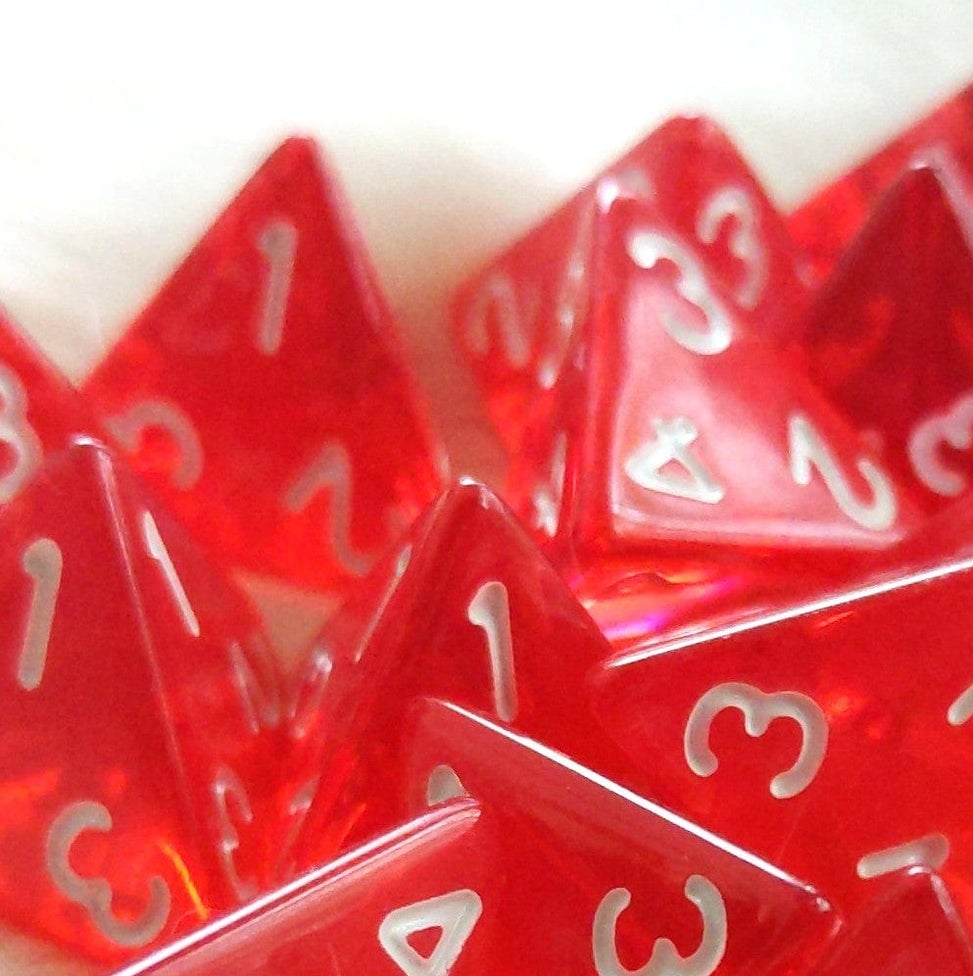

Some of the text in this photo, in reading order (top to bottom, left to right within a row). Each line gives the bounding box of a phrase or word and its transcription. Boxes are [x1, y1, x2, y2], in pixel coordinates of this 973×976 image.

[258, 218, 297, 356] 1
[628, 228, 734, 356] 3
[698, 188, 767, 311] 3
[625, 417, 724, 505] 4
[788, 415, 896, 531] 2
[22, 538, 62, 691] 1
[468, 581, 518, 722] 1
[685, 682, 828, 800] 3
[47, 801, 170, 947] 3
